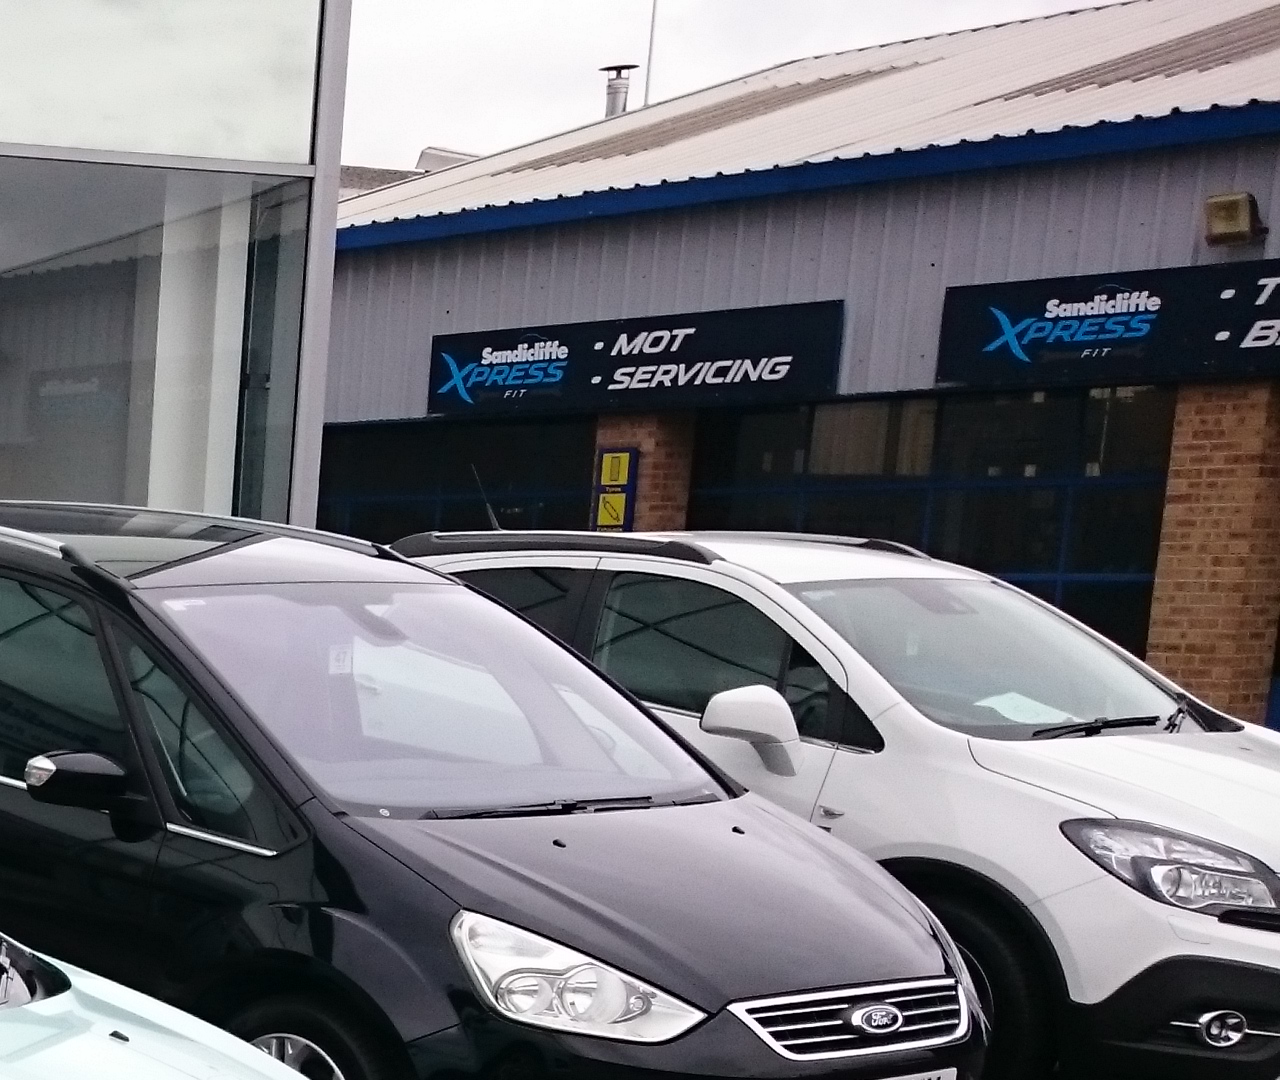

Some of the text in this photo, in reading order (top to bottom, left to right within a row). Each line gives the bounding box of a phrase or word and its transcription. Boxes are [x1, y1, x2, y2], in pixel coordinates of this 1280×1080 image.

[1044, 290, 1162, 319] Sandicliffe
[609, 328, 696, 356] MOT
[982, 306, 1159, 364] XPRESS
[481, 339, 569, 366] Sandicliffe
[1080, 347, 1112, 359] FIT
[437, 352, 568, 404] XPRESS
[607, 356, 793, 391] SERVICING
[503, 388, 528, 400] FIT
